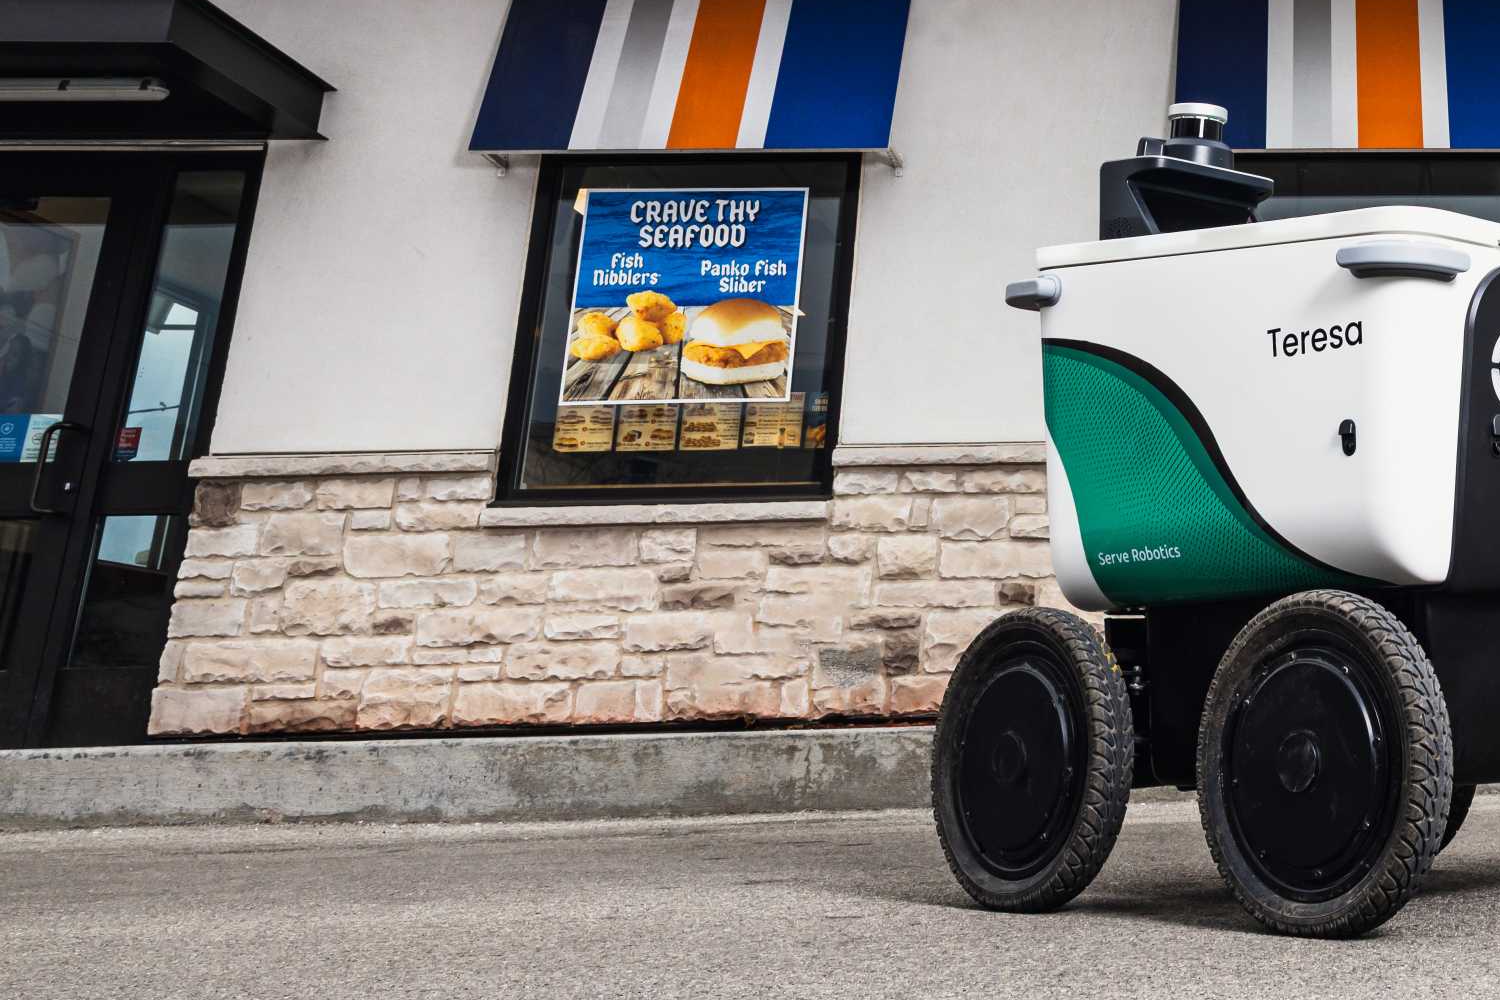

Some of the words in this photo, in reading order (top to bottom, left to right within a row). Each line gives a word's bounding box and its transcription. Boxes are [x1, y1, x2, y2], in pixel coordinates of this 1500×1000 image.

[630, 199, 710, 224] CRAVE
[715, 199, 760, 223] THY
[638, 224, 747, 248] SEAFOOD
[611, 252, 644, 269] Fish
[701, 259, 750, 277] Panko
[755, 259, 787, 277] Fish
[593, 269, 660, 286] Nibblers
[719, 276, 767, 293] Slider
[1267, 321, 1363, 357] Teresa
[1098, 552, 1130, 566] Serve
[1131, 544, 1181, 562] Robotics
